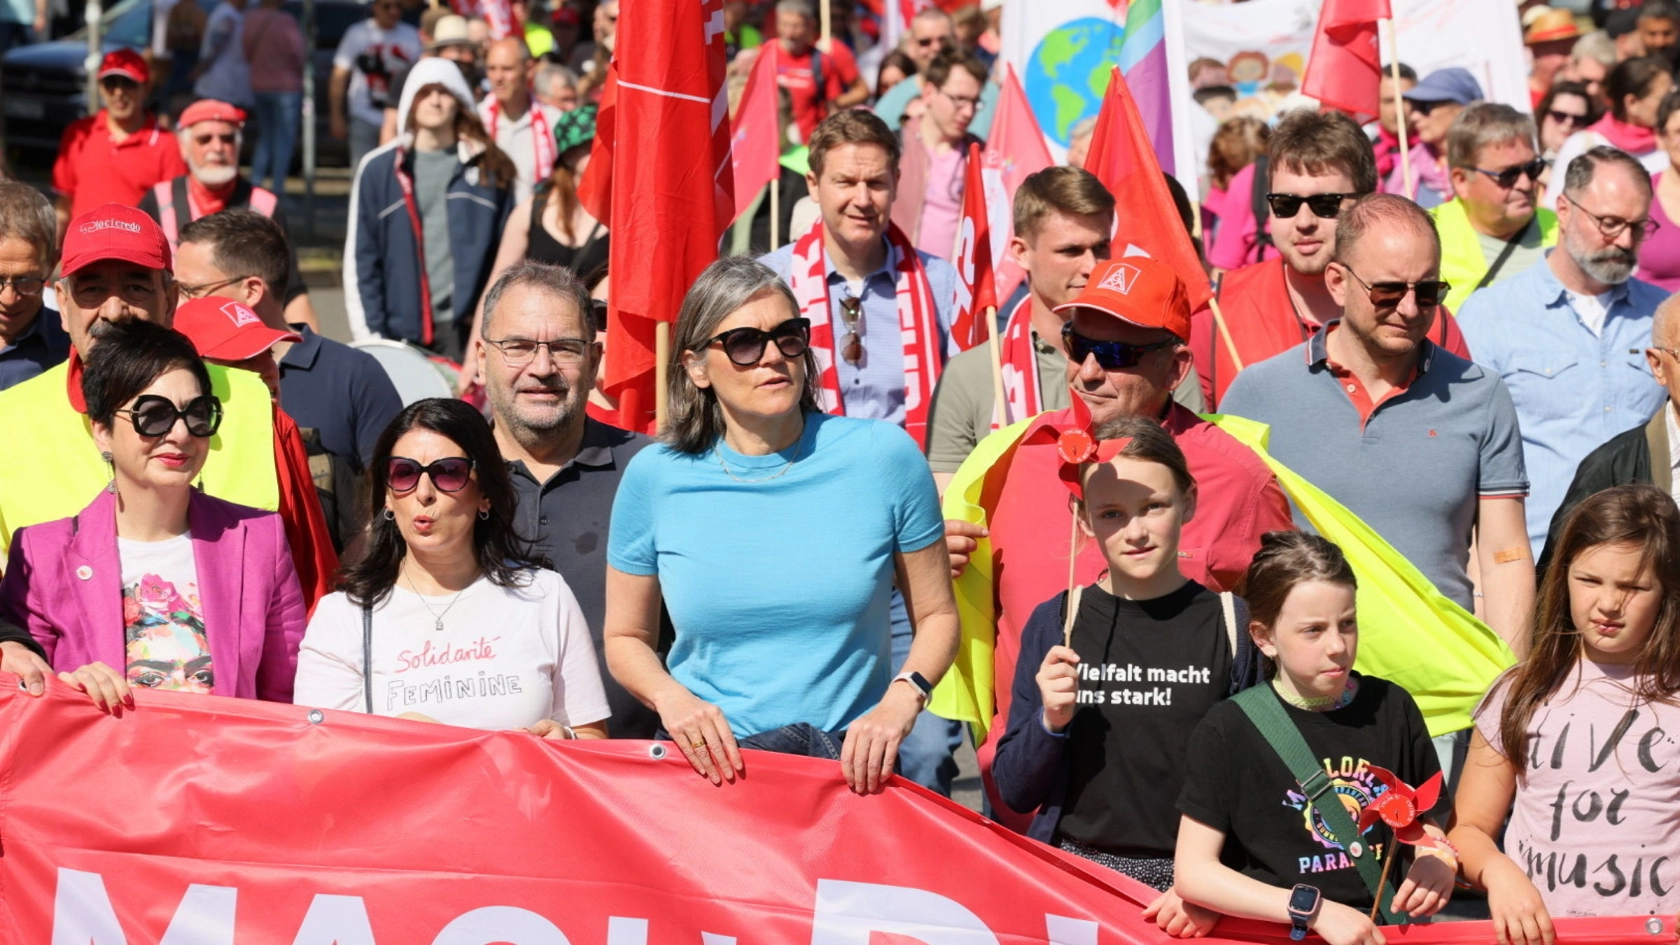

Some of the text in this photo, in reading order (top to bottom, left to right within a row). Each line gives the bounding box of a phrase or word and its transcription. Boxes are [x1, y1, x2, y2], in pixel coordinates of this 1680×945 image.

[394, 635, 502, 674] Solidarité
[1147, 665, 1211, 684] macht
[1110, 687, 1172, 706] stark!
[1549, 779, 1630, 842] for
[1521, 843, 1675, 898] music
